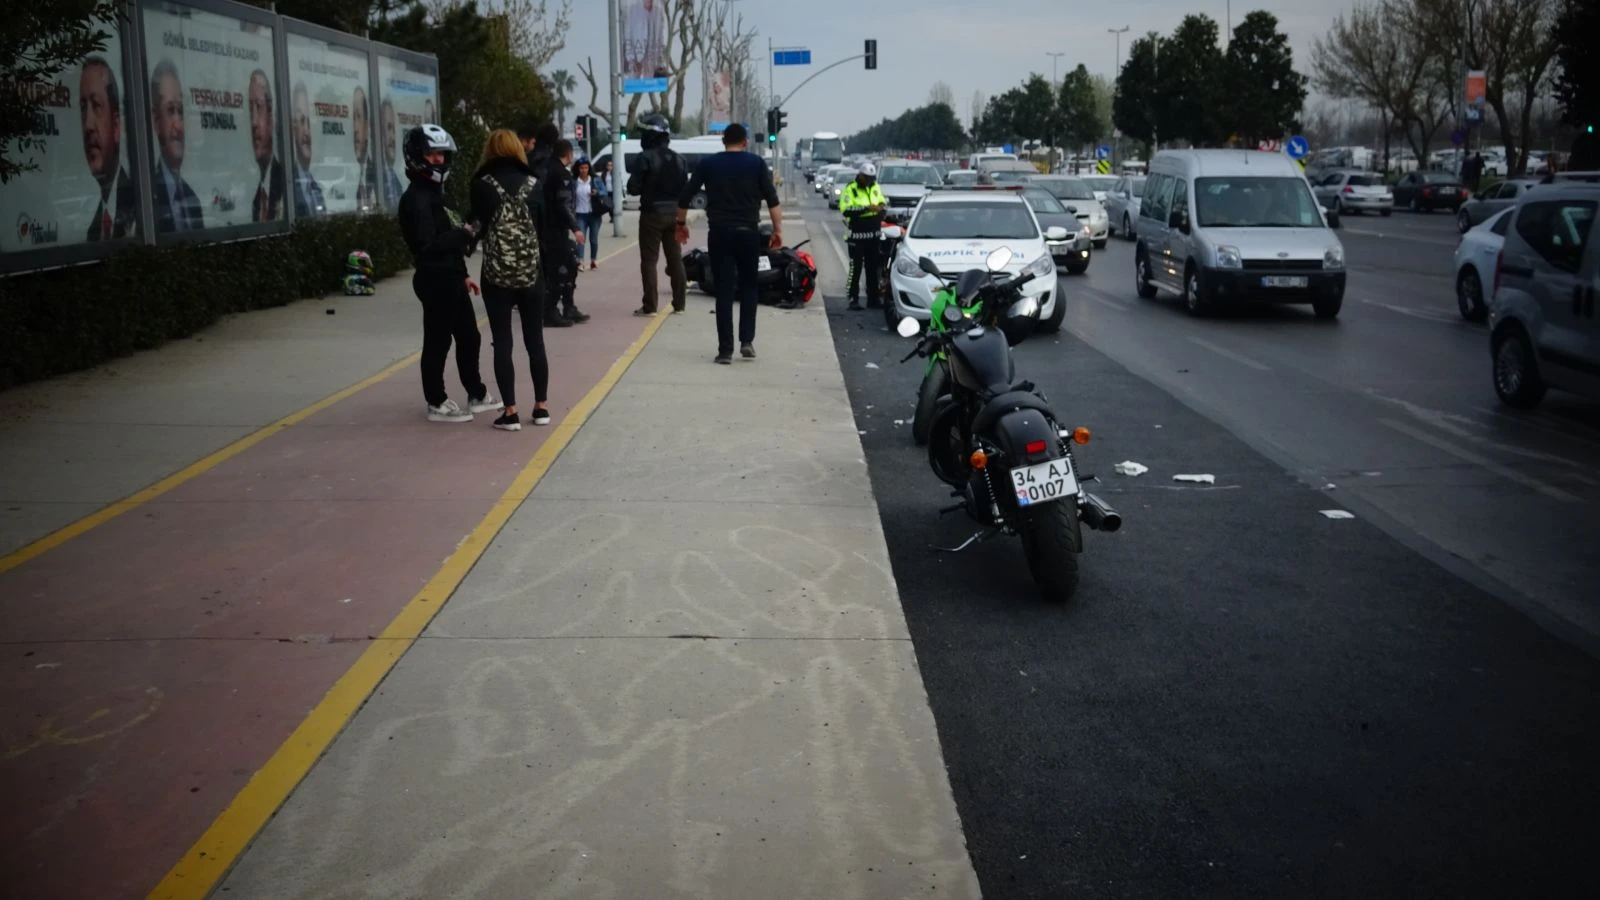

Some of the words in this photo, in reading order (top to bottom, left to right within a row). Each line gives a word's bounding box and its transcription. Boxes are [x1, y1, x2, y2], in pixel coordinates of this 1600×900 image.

[1014, 468, 1035, 486] 34
[1048, 460, 1071, 479] AJ
[1028, 479, 1065, 501] 0107
